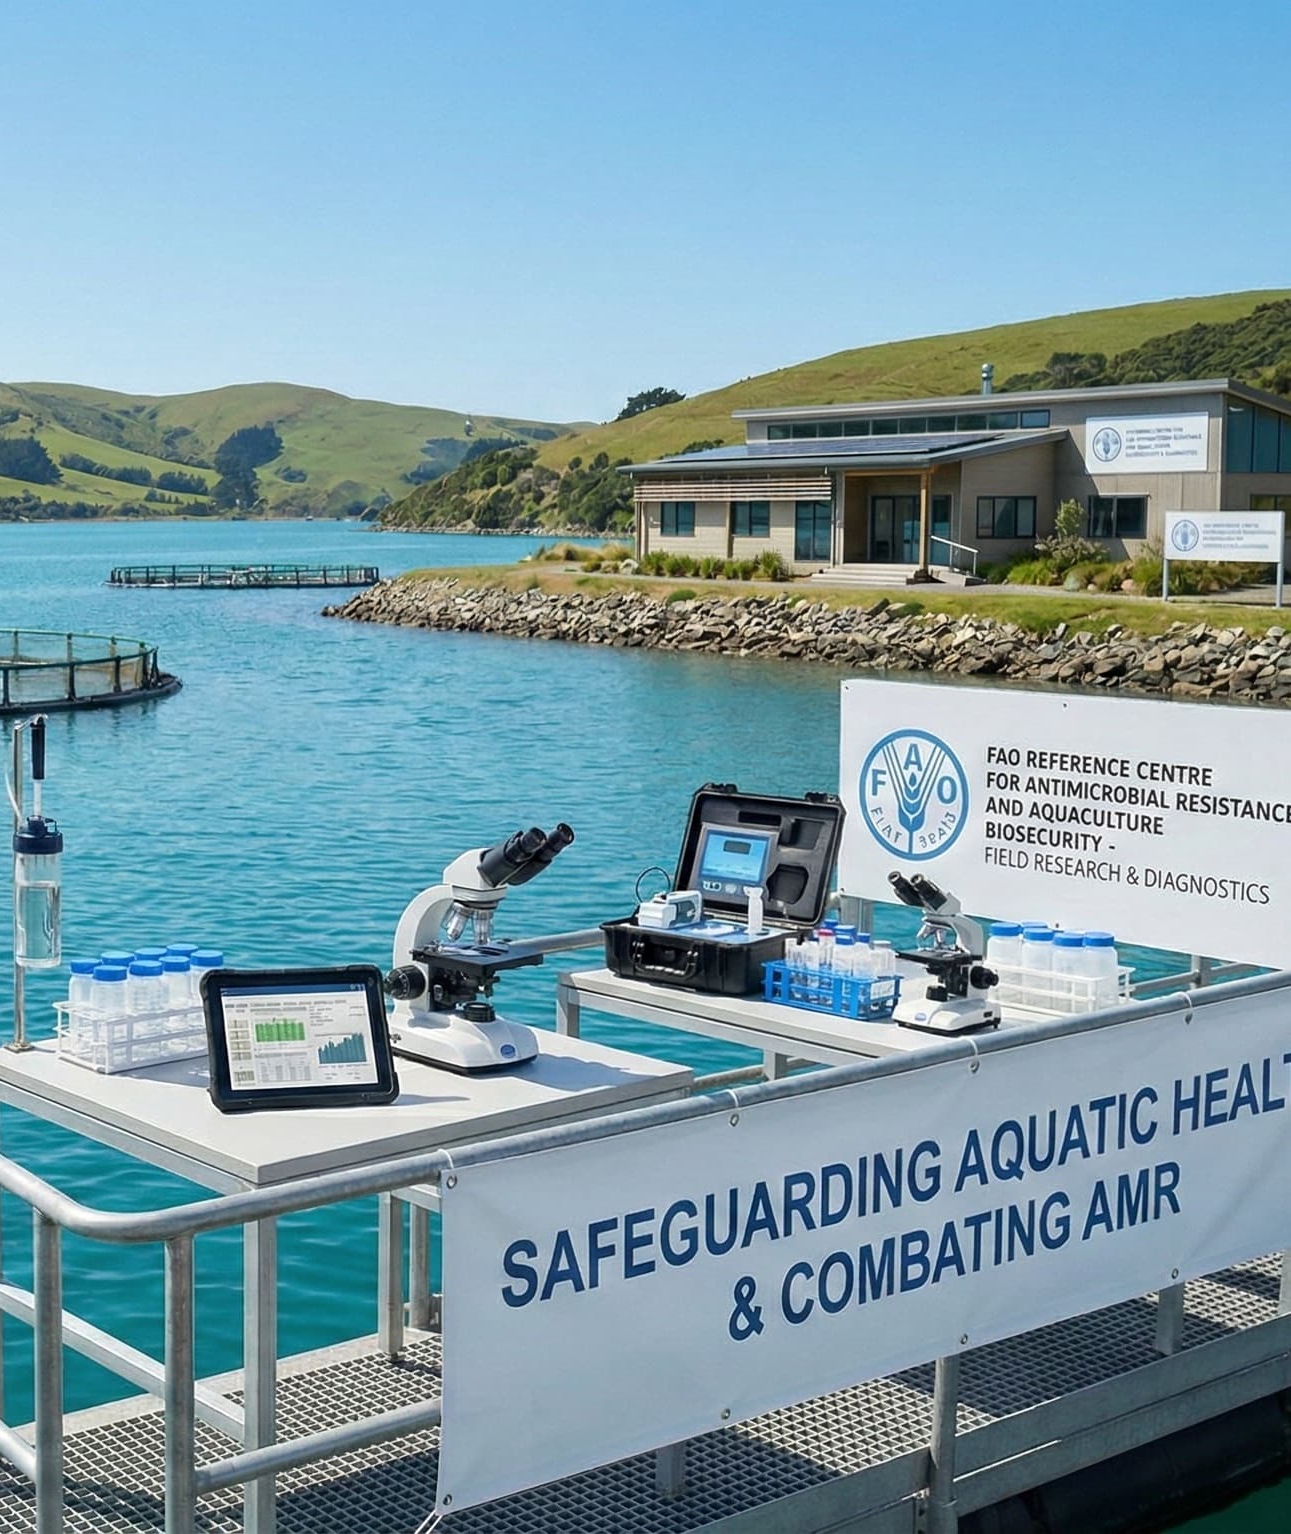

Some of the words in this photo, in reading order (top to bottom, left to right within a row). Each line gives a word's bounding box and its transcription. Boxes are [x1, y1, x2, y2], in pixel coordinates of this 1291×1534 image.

[987, 746, 1020, 766] FAO
[1026, 750, 1130, 778] REFERENCE
[1136, 761, 1213, 787] CENTRE
[986, 771, 1020, 792] FOR
[1024, 776, 1170, 809] ANTIMICROBIAL
[985, 796, 1023, 817] AND
[1028, 801, 1164, 836] AQUACULTURE
[986, 821, 1103, 853] BIOSECURITY
[985, 846, 1029, 869] FIELD
[1034, 853, 1121, 882] RESEARCH
[1126, 866, 1140, 885] &
[1144, 868, 1270, 905] DIAGNOSTICS
[501, 1140, 942, 1308] SAFEGUARDING
[954, 1086, 1159, 1193] AQUATIC
[1172, 1052, 1291, 1136] HEAL
[728, 1275, 766, 1341] &
[781, 1191, 1071, 1325] COMBATING
[1081, 1161, 1181, 1241] AMR
